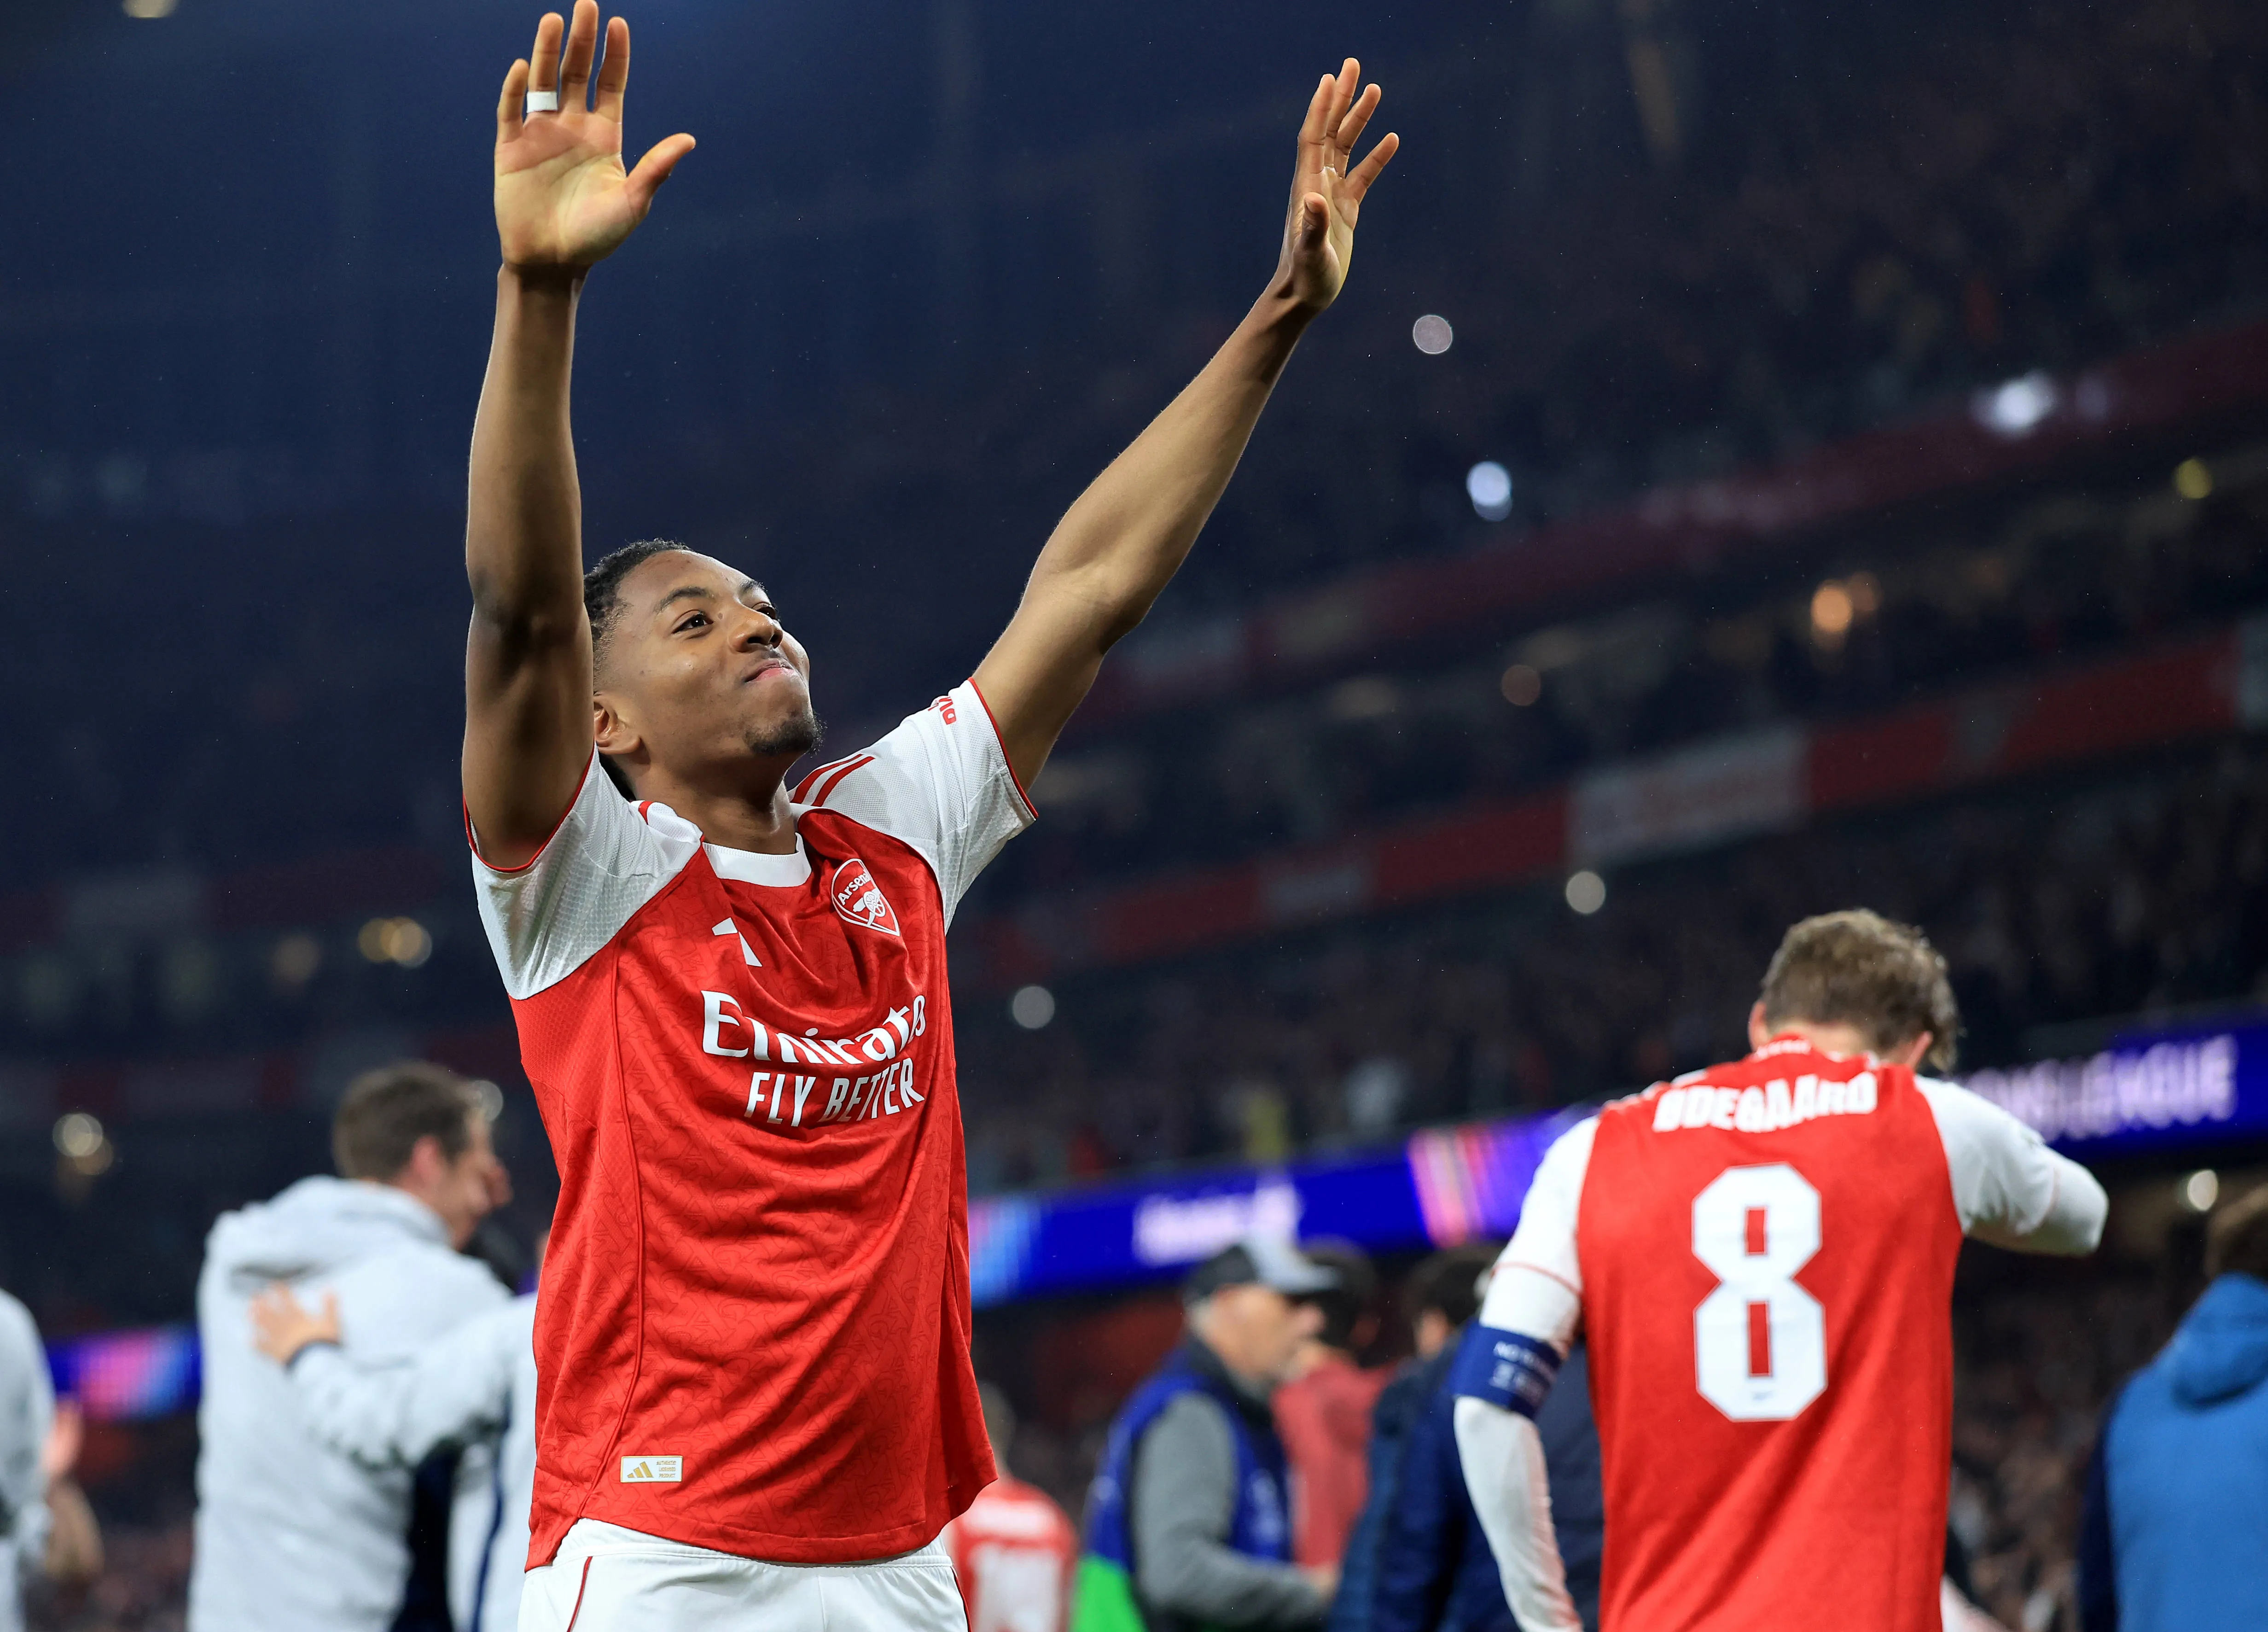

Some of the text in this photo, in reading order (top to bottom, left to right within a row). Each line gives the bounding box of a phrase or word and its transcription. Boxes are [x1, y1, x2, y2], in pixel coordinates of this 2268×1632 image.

[744, 1058, 925, 1127] FLY BETTER
[1692, 1161, 1828, 1422] 8
